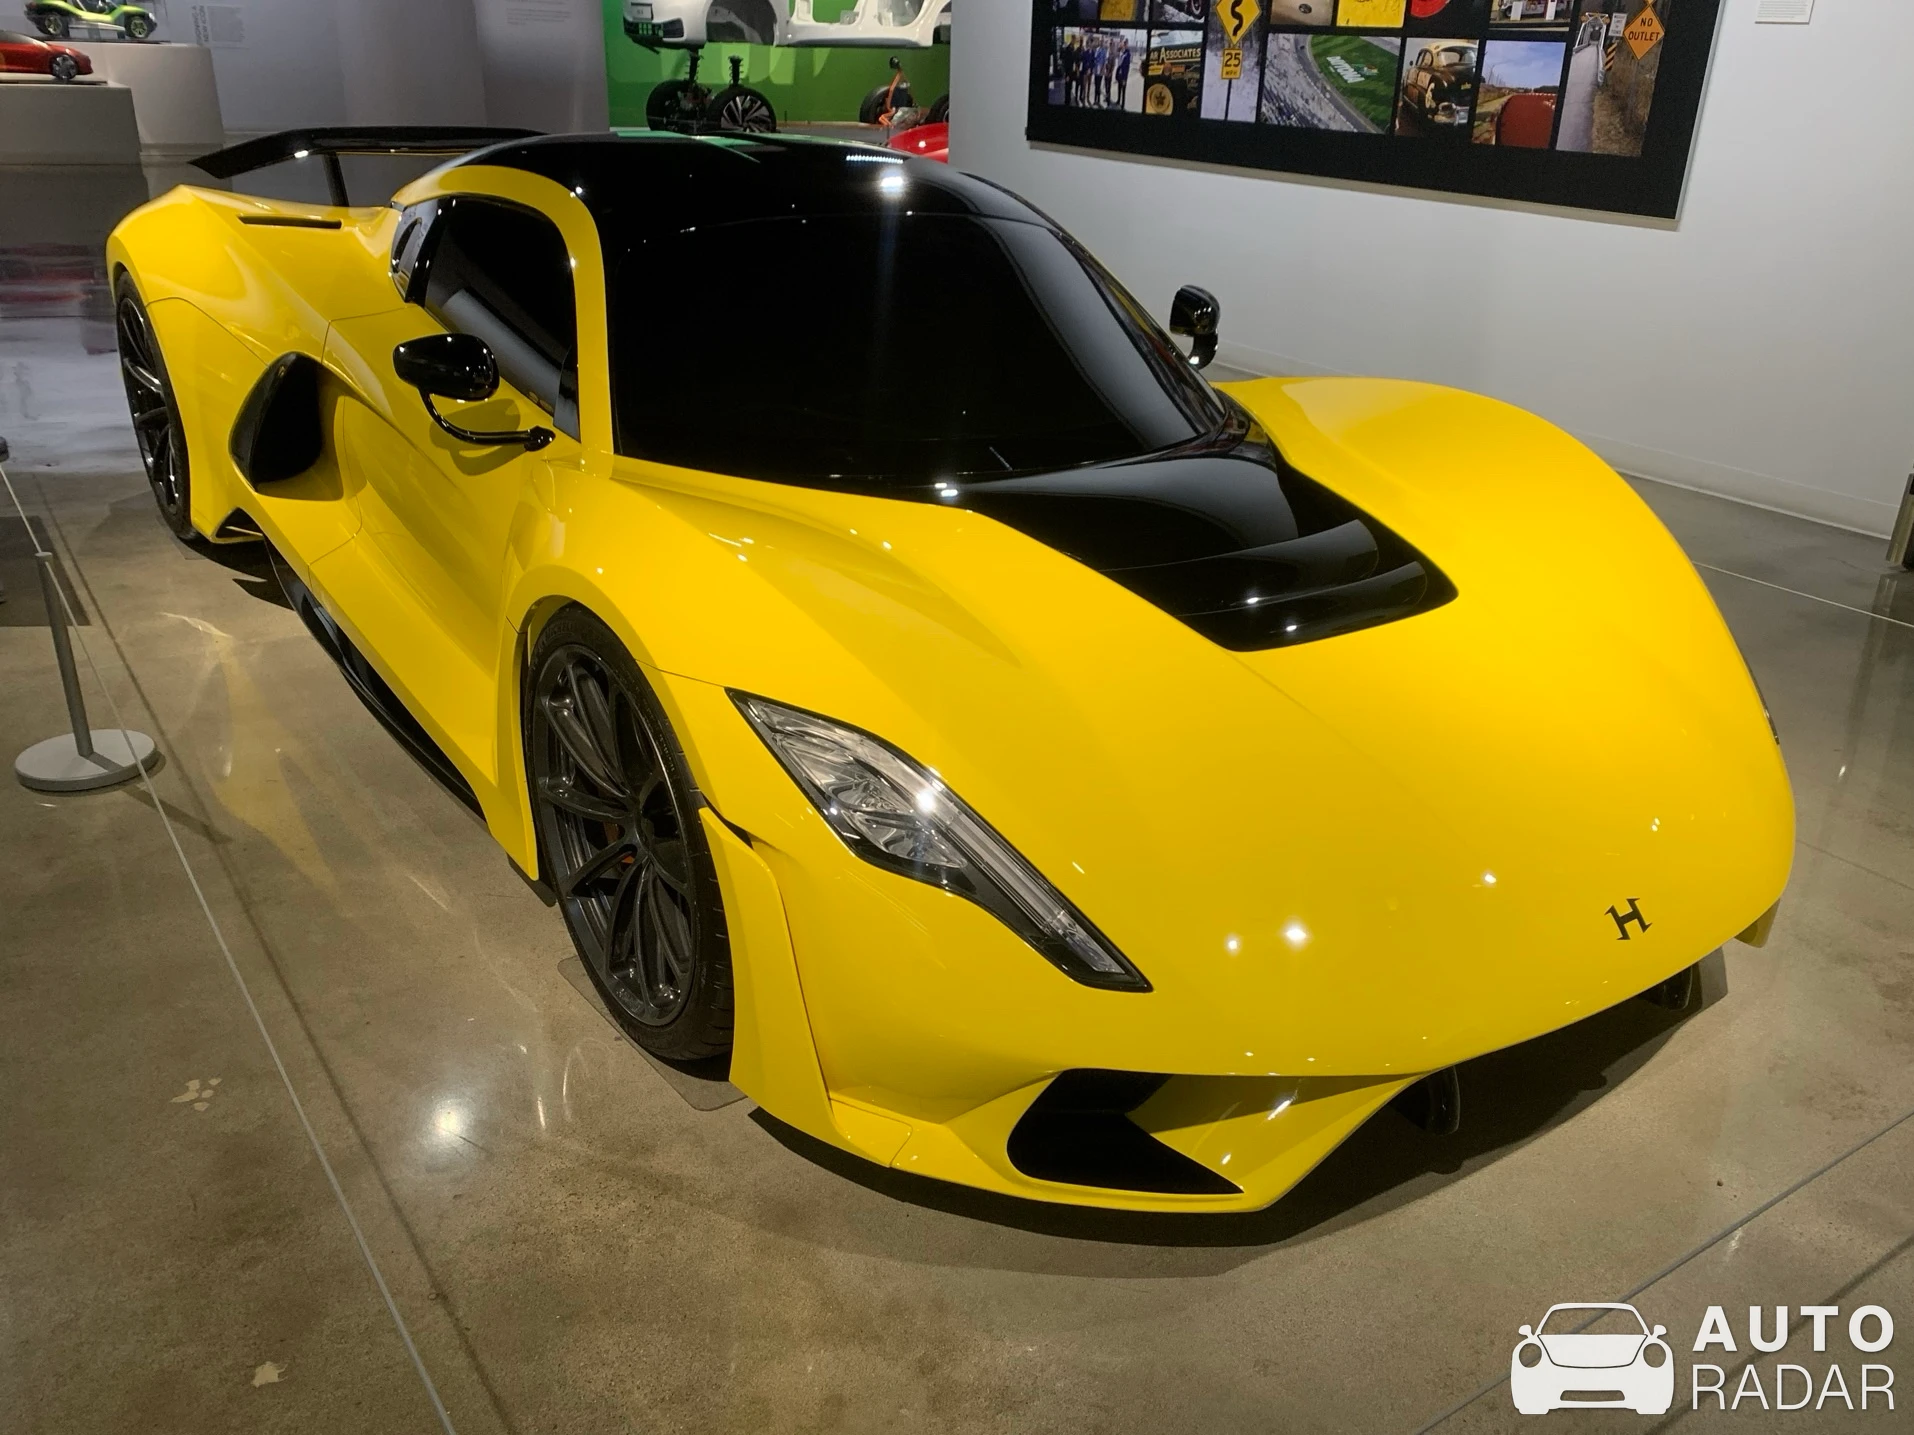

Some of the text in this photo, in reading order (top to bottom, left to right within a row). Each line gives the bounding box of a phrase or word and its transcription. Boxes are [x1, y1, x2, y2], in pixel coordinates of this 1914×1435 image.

[1640, 17, 1653, 27] NO
[1628, 31, 1660, 41] OUTLET
[1160, 47, 1201, 63] ASSOCIATES
[1224, 52, 1241, 67] 25
[1604, 897, 1653, 941] H
